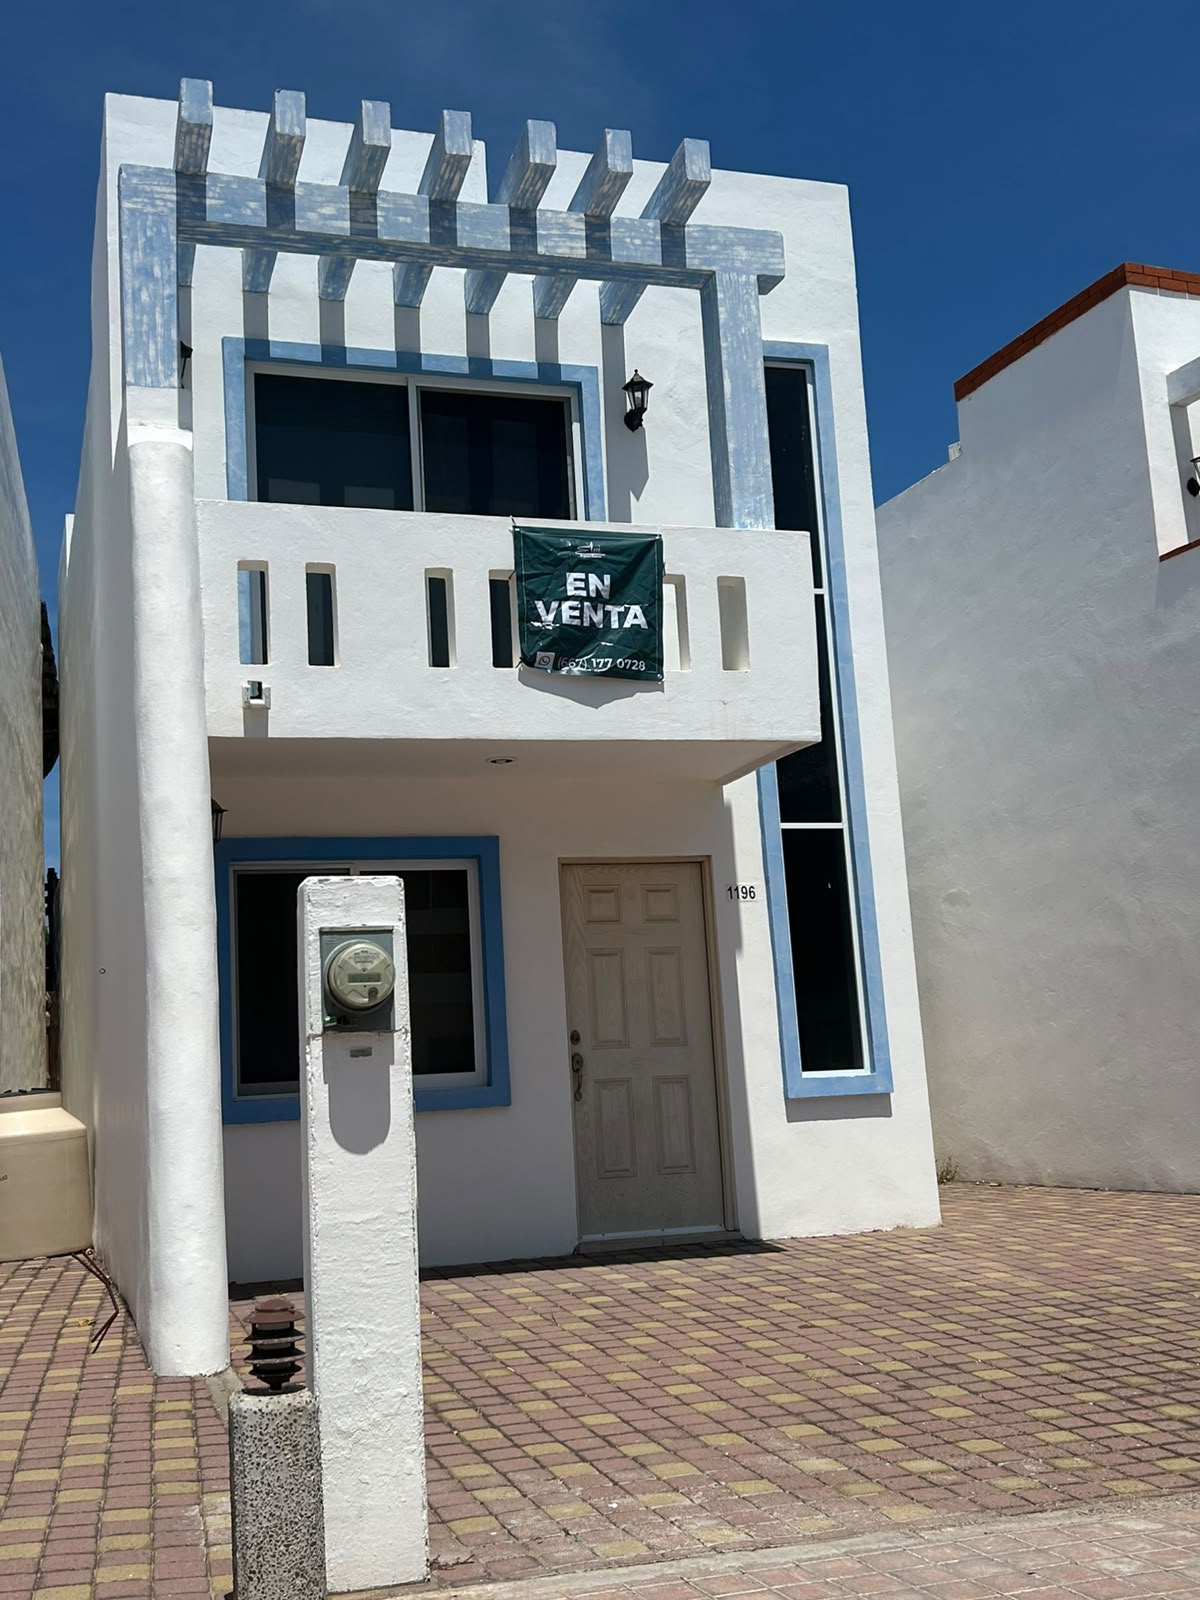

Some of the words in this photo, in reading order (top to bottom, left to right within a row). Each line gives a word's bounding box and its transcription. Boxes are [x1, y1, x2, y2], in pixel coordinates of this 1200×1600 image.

[566, 572, 611, 599] EN
[534, 600, 648, 629] VENTA
[591, 658, 613, 668] 177
[617, 659, 646, 671] 0728
[727, 885, 756, 900] 1196
